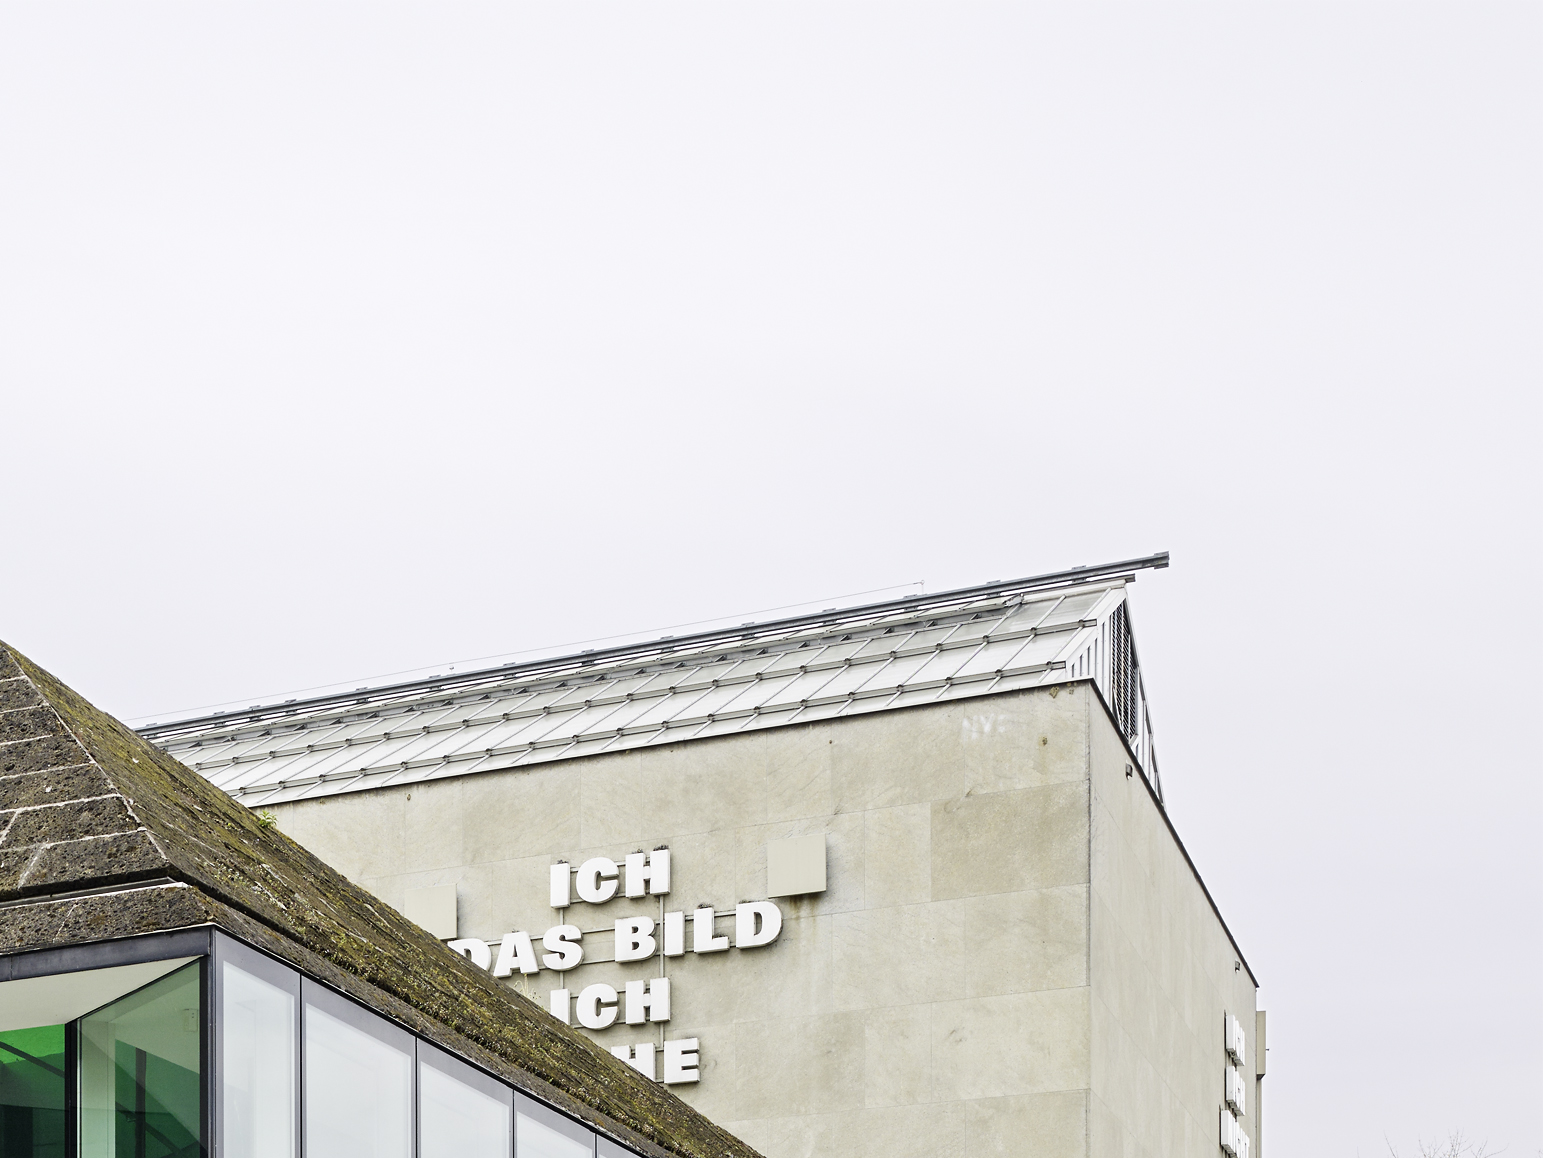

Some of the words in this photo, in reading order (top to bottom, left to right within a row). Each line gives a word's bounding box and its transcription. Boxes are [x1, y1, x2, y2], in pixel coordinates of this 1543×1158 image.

[550, 849, 671, 909] ICH
[448, 923, 586, 977] DAS
[615, 900, 783, 963] BILD
[550, 977, 671, 1030] ICH
